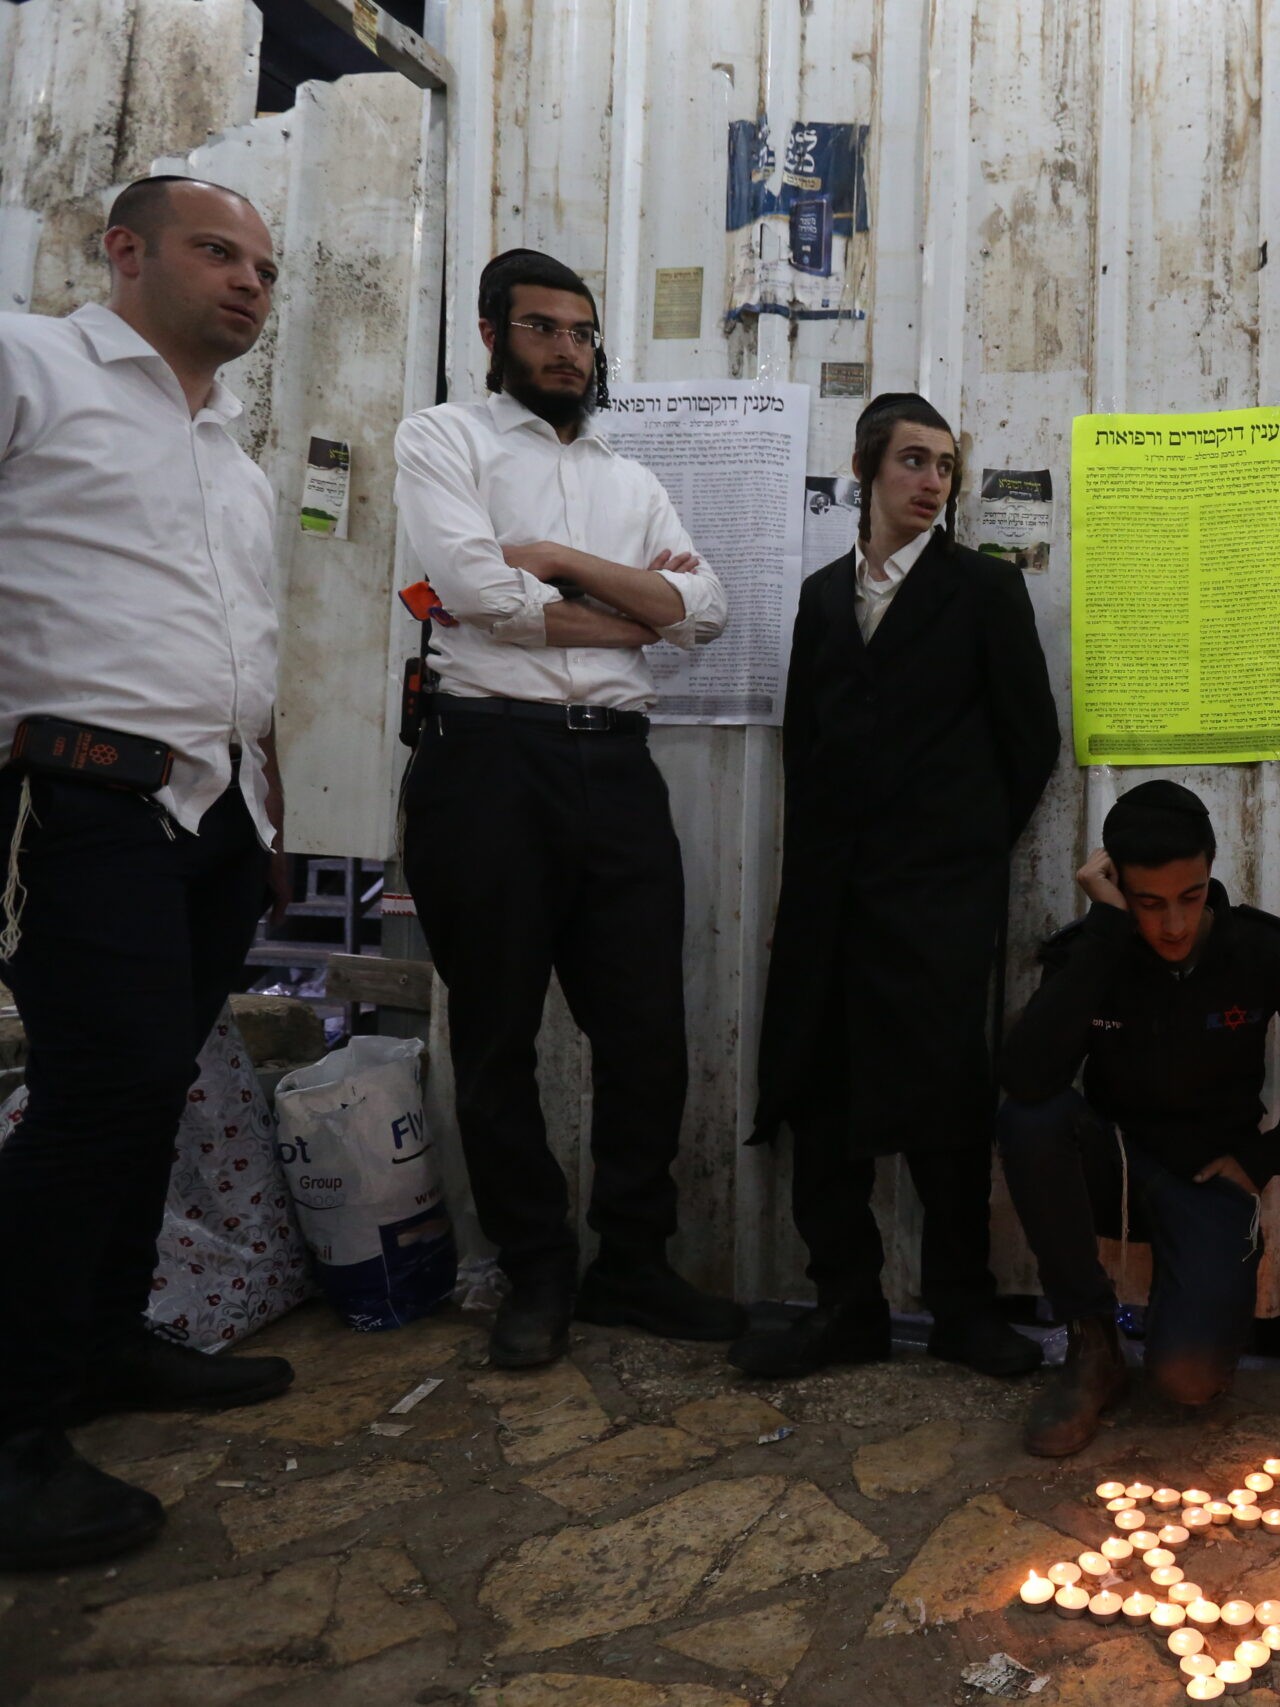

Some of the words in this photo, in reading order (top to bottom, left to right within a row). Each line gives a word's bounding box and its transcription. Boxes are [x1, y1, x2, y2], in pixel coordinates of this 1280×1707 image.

[667, 396, 738, 416] דוקטורים
[743, 396, 784, 415] מענין
[1096, 431, 1161, 445] ורפואות
[1170, 427, 1243, 448] דוקטורים
[300, 1175, 343, 1191] Group
